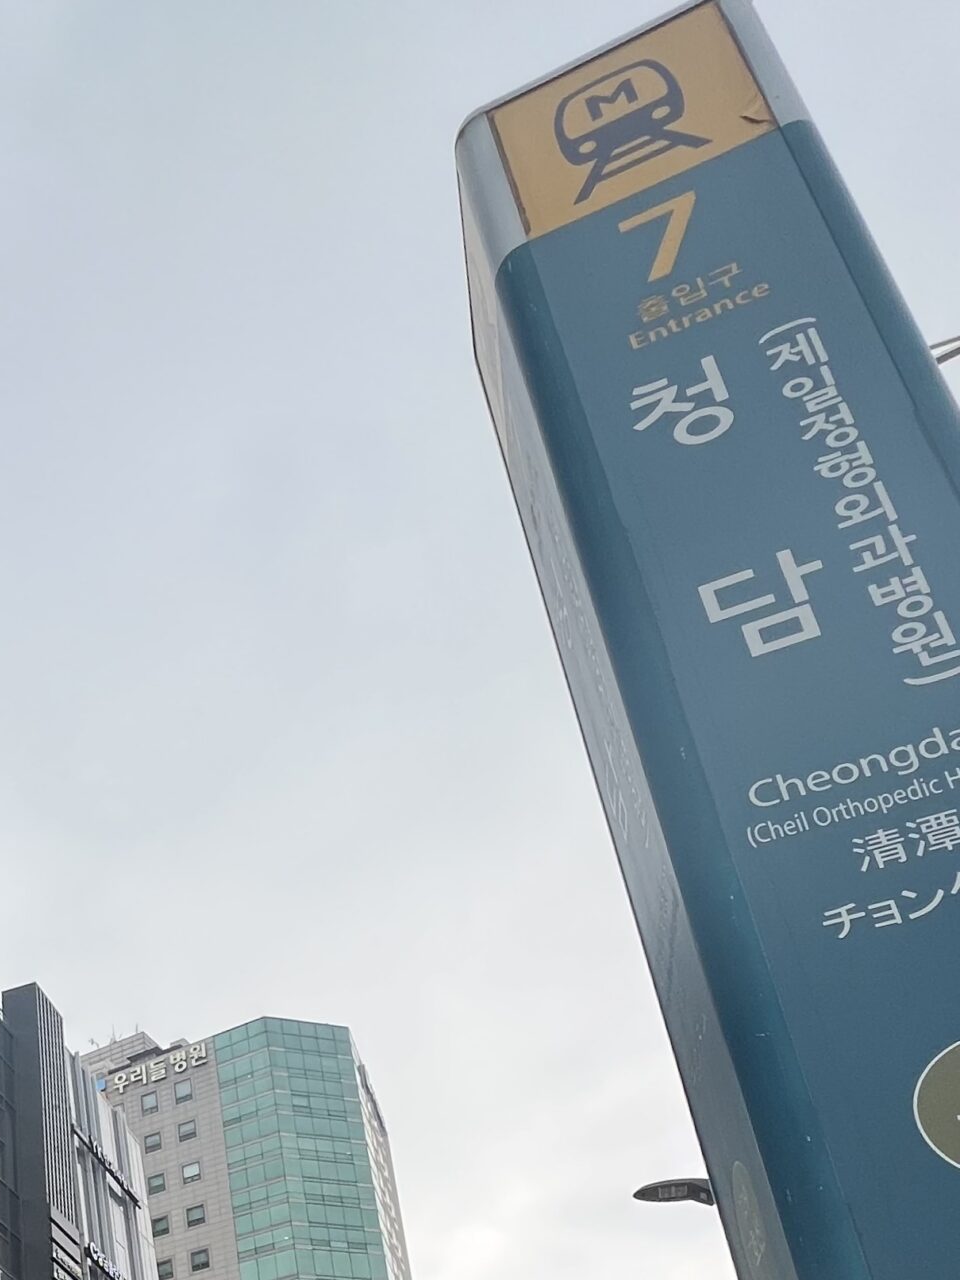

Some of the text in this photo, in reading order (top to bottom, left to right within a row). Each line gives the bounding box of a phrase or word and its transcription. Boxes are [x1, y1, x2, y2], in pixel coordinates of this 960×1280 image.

[618, 190, 696, 283] 7
[628, 283, 770, 350] Entrance
[638, 262, 743, 323] 출입구
[746, 811, 810, 848] (Cheil
[812, 777, 944, 828] Orthopedic
[112, 1042, 208, 1095] 우리들병원
